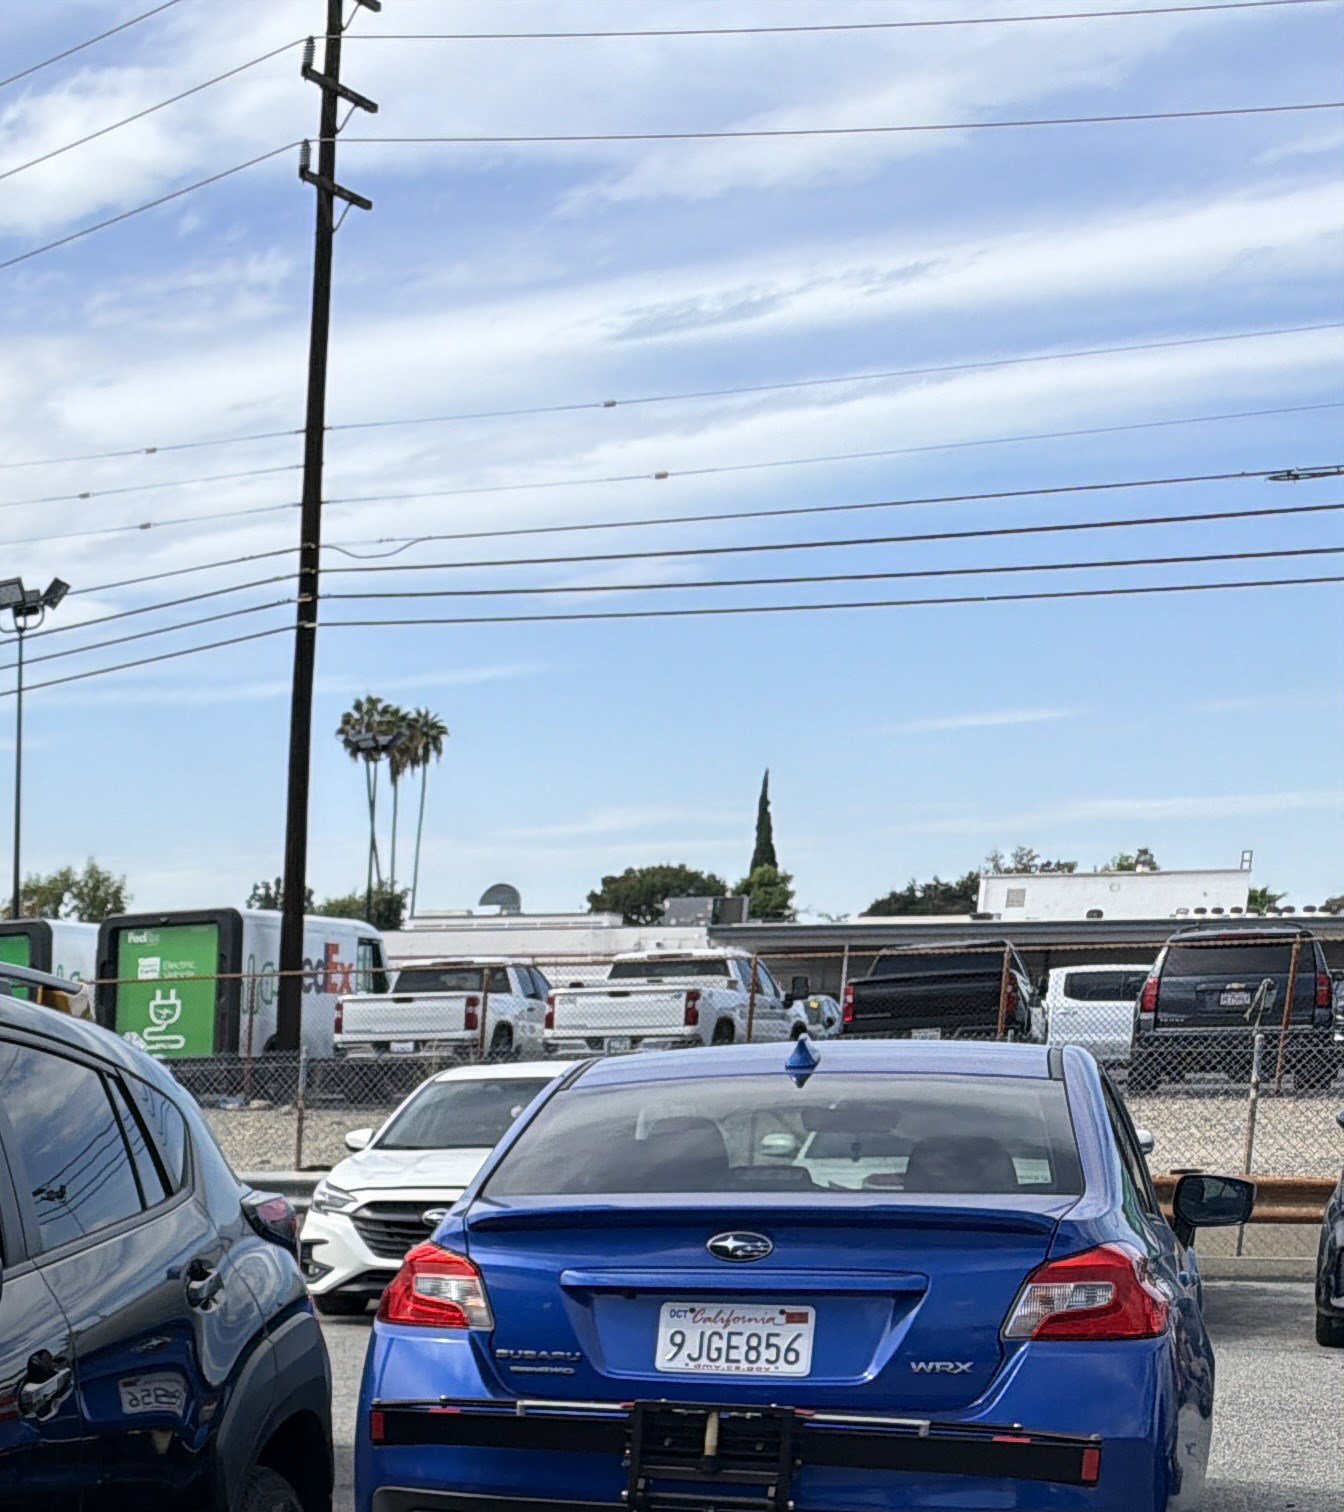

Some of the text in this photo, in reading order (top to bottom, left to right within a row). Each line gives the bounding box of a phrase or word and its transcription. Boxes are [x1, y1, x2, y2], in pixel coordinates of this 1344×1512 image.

[669, 1309, 688, 1319] OCT
[692, 1308, 786, 1329] California
[665, 1330, 803, 1366] 9JGE856
[495, 1349, 581, 1361] SUBARU
[910, 1361, 974, 1374] WRX
